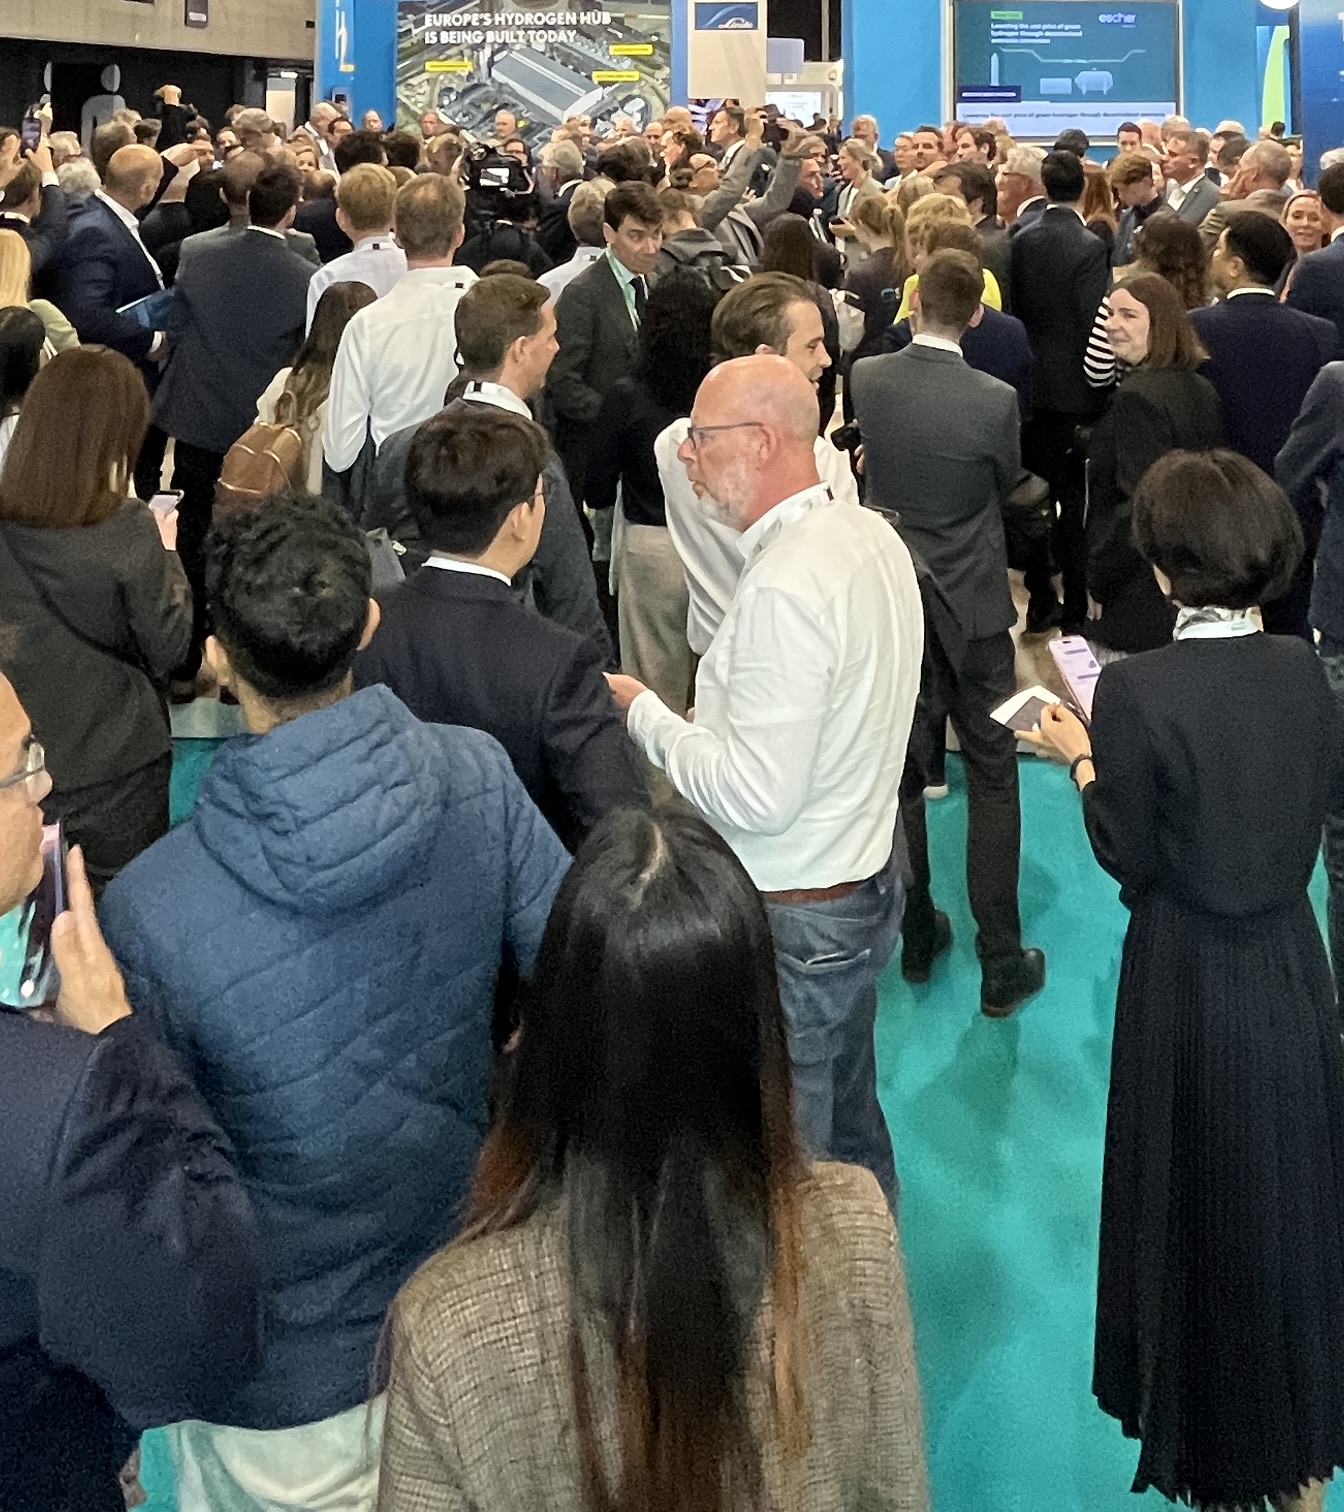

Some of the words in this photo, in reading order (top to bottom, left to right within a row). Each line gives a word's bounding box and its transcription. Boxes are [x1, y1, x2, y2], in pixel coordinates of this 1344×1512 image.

[424, 12, 492, 28] EUROPE'S
[494, 12, 578, 26] HYDROGEN
[579, 10, 612, 25] HUB
[718, 17, 754, 29] Linde
[424, 31, 438, 44] IS
[440, 31, 484, 44] BEING
[486, 30, 526, 43] BUILT
[527, 29, 577, 43] TODAY
